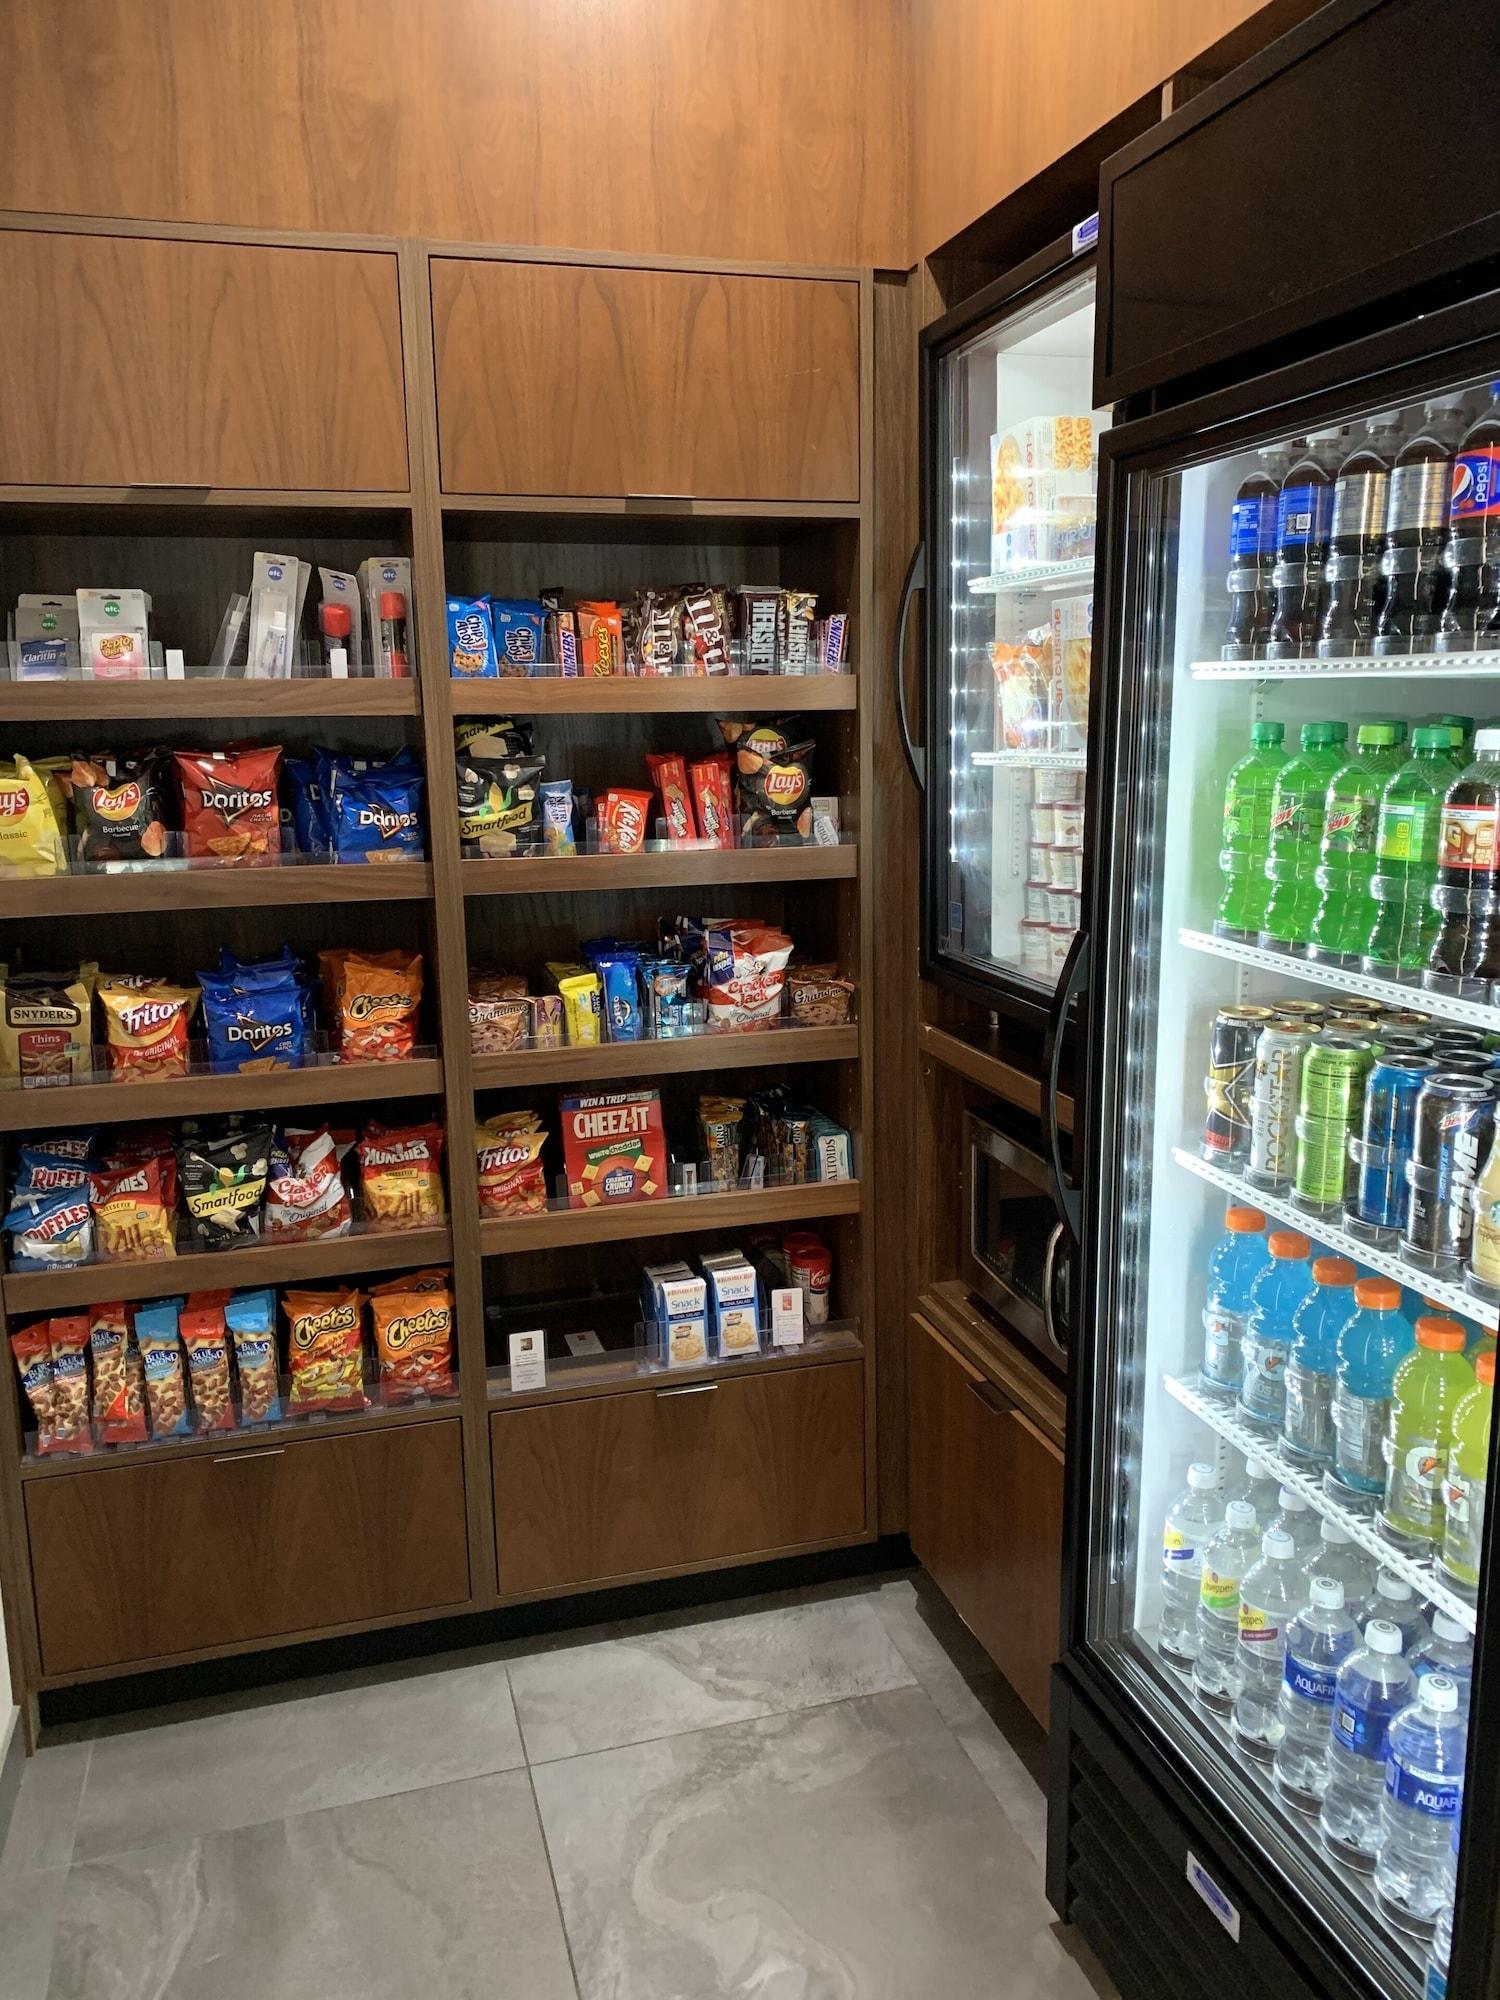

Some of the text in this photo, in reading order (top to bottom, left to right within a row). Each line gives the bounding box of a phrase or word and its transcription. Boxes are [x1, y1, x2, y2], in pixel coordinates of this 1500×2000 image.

[1475, 462, 1490, 503] pepsi
[104, 604, 120, 612] etc.
[466, 614, 485, 646] Chips
[100, 637, 130, 650] Pepto
[515, 627, 533, 660] Chips
[23, 651, 56, 662] Claritin
[96, 787, 137, 810] Lay's
[201, 789, 272, 809] Doritos
[359, 811, 418, 827] Doritos
[556, 795, 567, 823] NUTRI
[102, 824, 140, 833] Barbecue
[461, 807, 526, 835] Smartfood
[728, 973, 782, 994] Cracker
[735, 989, 769, 1008] Jack
[14, 1009, 73, 1020] SNYDER'S
[613, 995, 625, 1027] OREO
[736, 1007, 770, 1023] Original
[29, 1034, 61, 1044] Thins
[227, 1022, 293, 1042] Doritos
[145, 1036, 180, 1056] ORIGINAL
[580, 1098, 597, 1108] WIN
[597, 1097, 605, 1106] A
[606, 1095, 627, 1105] TRIP
[715, 1123, 725, 1149] KIND
[792, 1121, 801, 1144] KIND
[364, 1142, 430, 1167] MUNCHIES
[477, 1146, 530, 1173] Fritos
[826, 1139, 838, 1181] ALTOIDS
[492, 1175, 525, 1194] ORIGINAL
[605, 1174, 634, 1184] CELEBRITY
[605, 1180, 633, 1191] CRUNCH
[1449, 1131, 1479, 1240] GAME
[191, 1185, 263, 1214] Smartfood
[288, 1202, 327, 1224] Original
[721, 1285, 751, 1296] Snack
[671, 1297, 700, 1310] Snack
[92, 1332, 110, 1342] BLUE
[295, 1306, 354, 1348] Cheetos
[387, 1309, 449, 1349] Cheetos
[58, 1355, 77, 1367] BLUE
[145, 1350, 166, 1363] BLUE
[191, 1349, 212, 1361] BLUE
